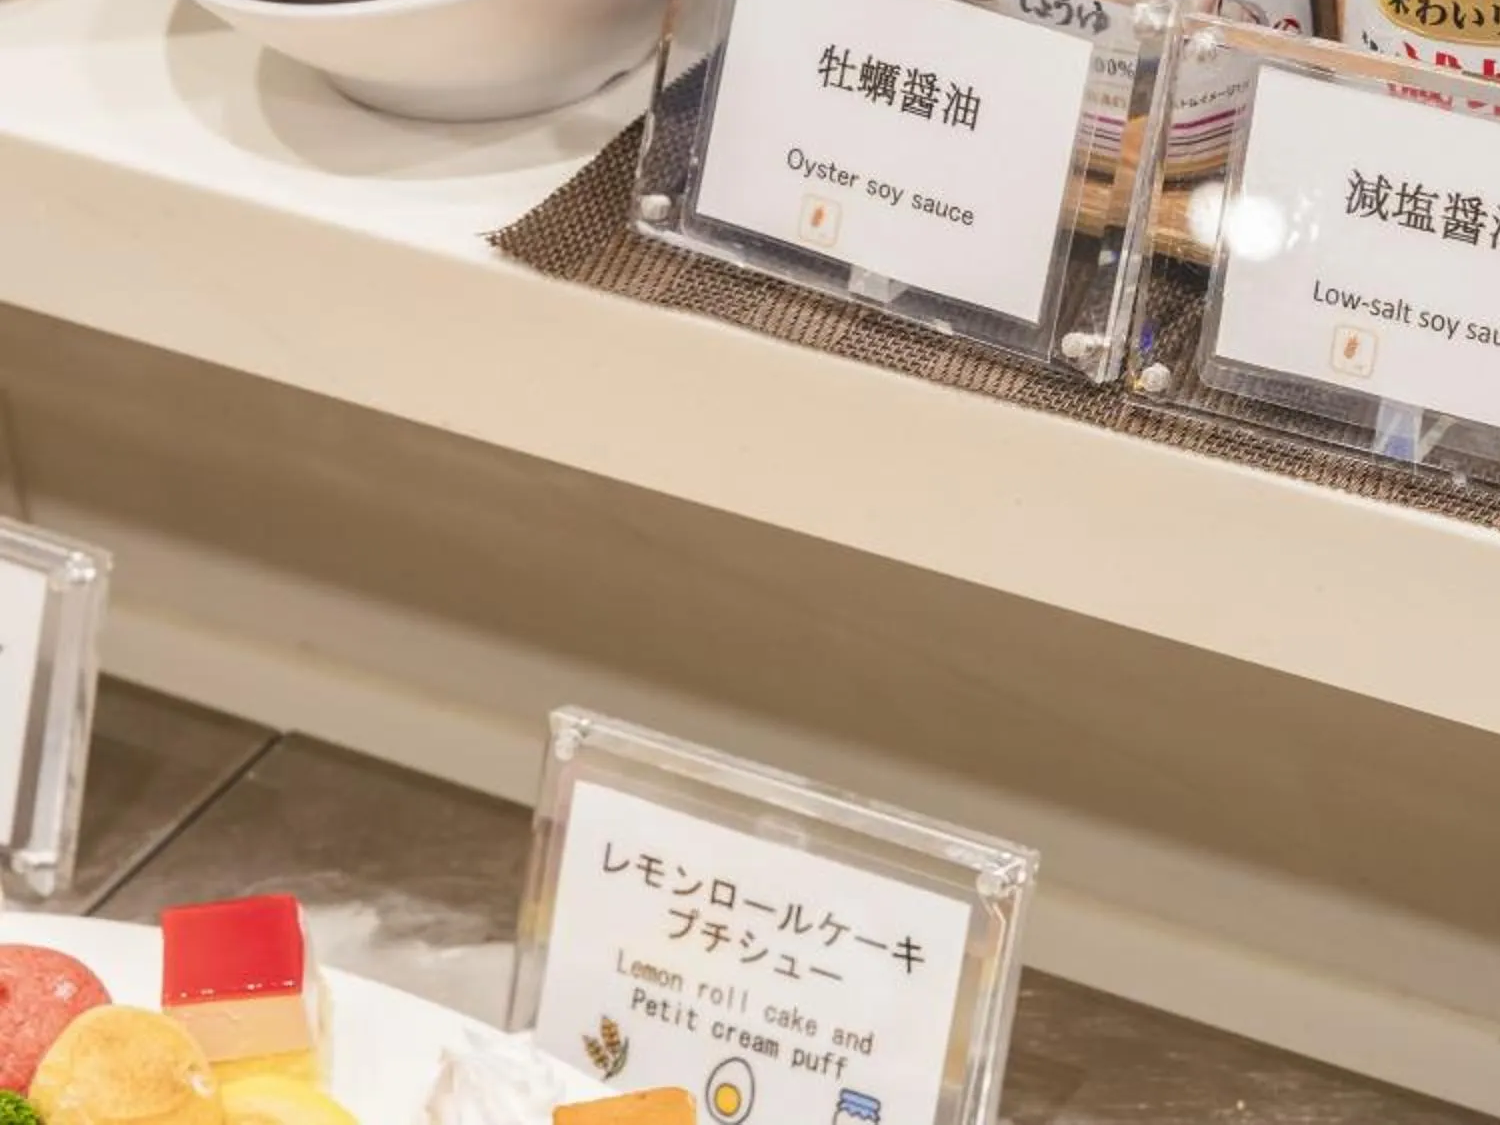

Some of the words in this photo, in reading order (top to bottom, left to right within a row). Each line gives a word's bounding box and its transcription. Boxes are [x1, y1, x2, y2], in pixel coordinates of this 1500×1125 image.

[786, 148, 860, 187] Oyster
[865, 177, 905, 206] soy
[911, 192, 975, 226] sauce
[1313, 279, 1412, 324] Low-salt
[1418, 309, 1460, 340] soy
[601, 841, 926, 975] レモンロールケーキ
[667, 907, 844, 983] プチシュー
[615, 948, 683, 991] Lemon
[697, 980, 749, 1014] roll
[763, 1003, 818, 1038] cake
[831, 1022, 876, 1056] and
[631, 987, 699, 1032] Petit
[711, 1021, 779, 1058] cream
[791, 1046, 849, 1080] puff
